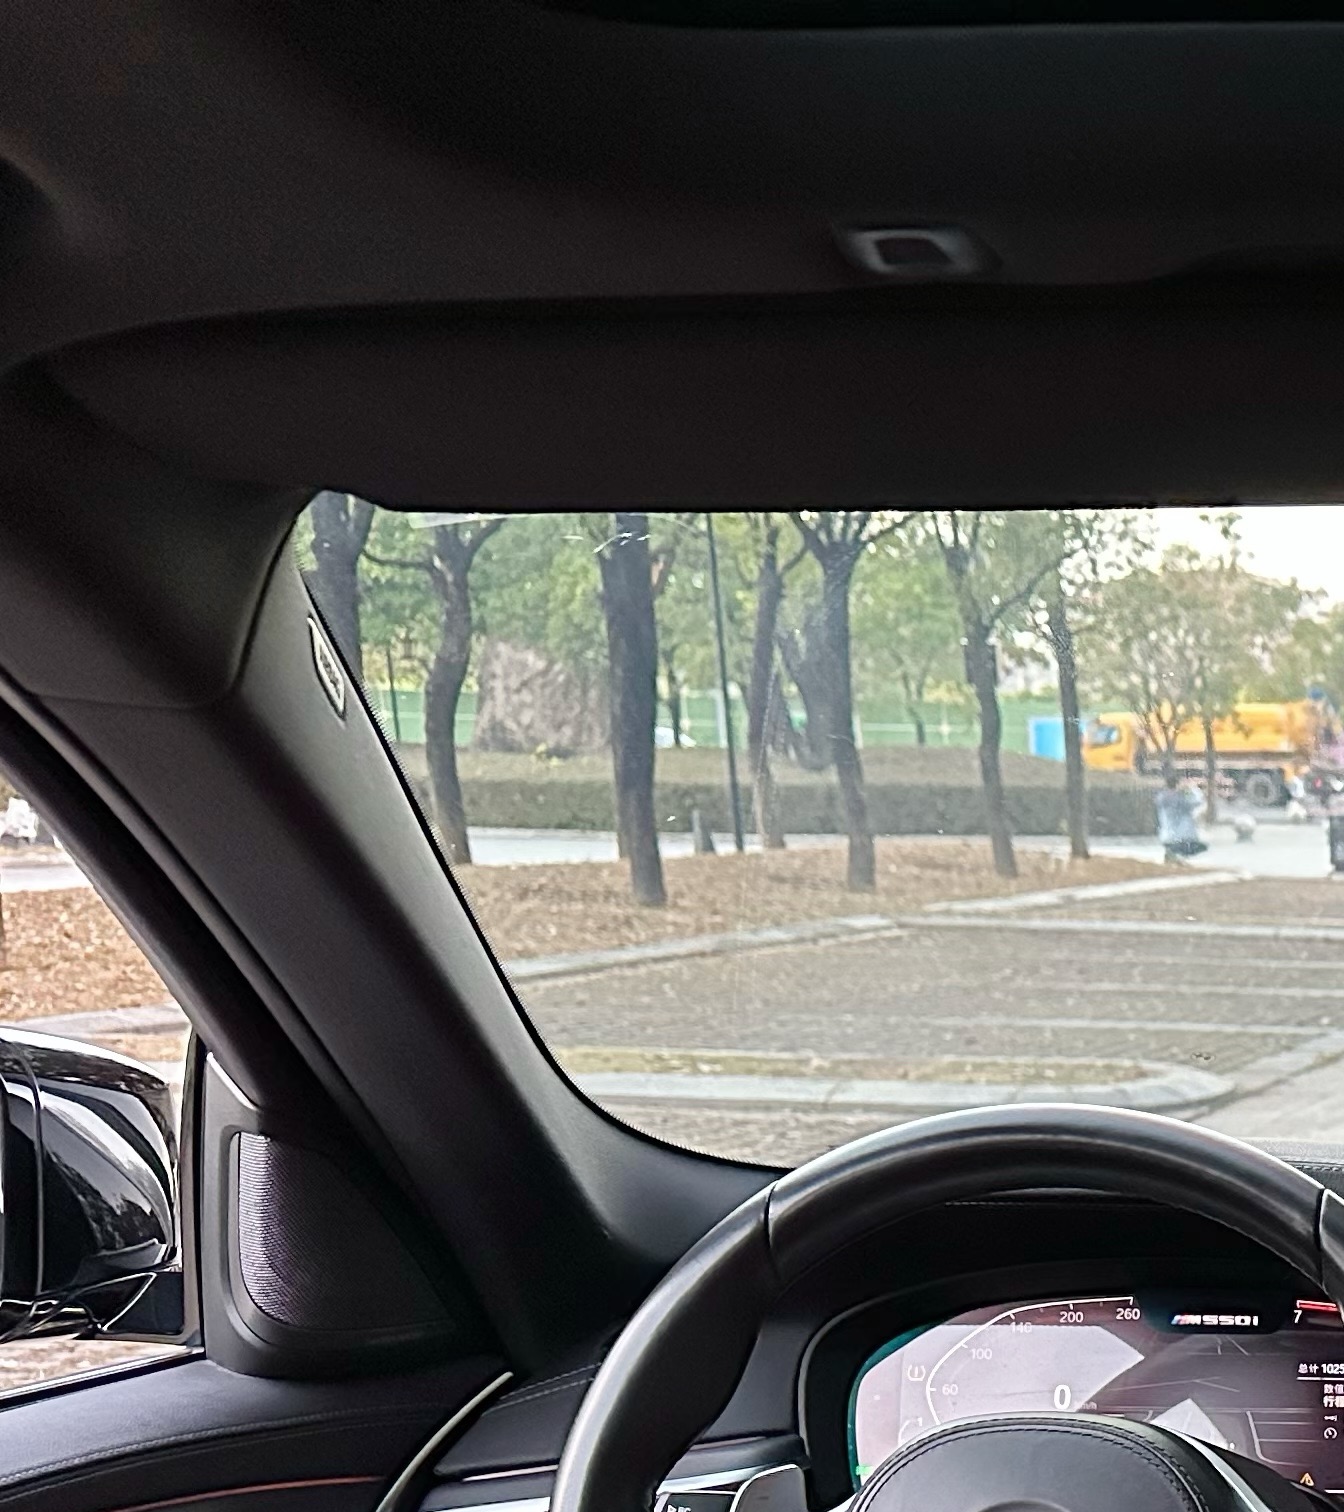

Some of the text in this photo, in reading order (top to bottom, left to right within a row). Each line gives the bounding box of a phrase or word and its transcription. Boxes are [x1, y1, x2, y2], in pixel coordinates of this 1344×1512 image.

[1059, 1311, 1084, 1323] 200
[1116, 1308, 1141, 1321] 260
[1293, 1309, 1302, 1324] 7
[971, 1348, 993, 1360] 100
[941, 1384, 959, 1396] 60
[1053, 1385, 1072, 1410] 0
